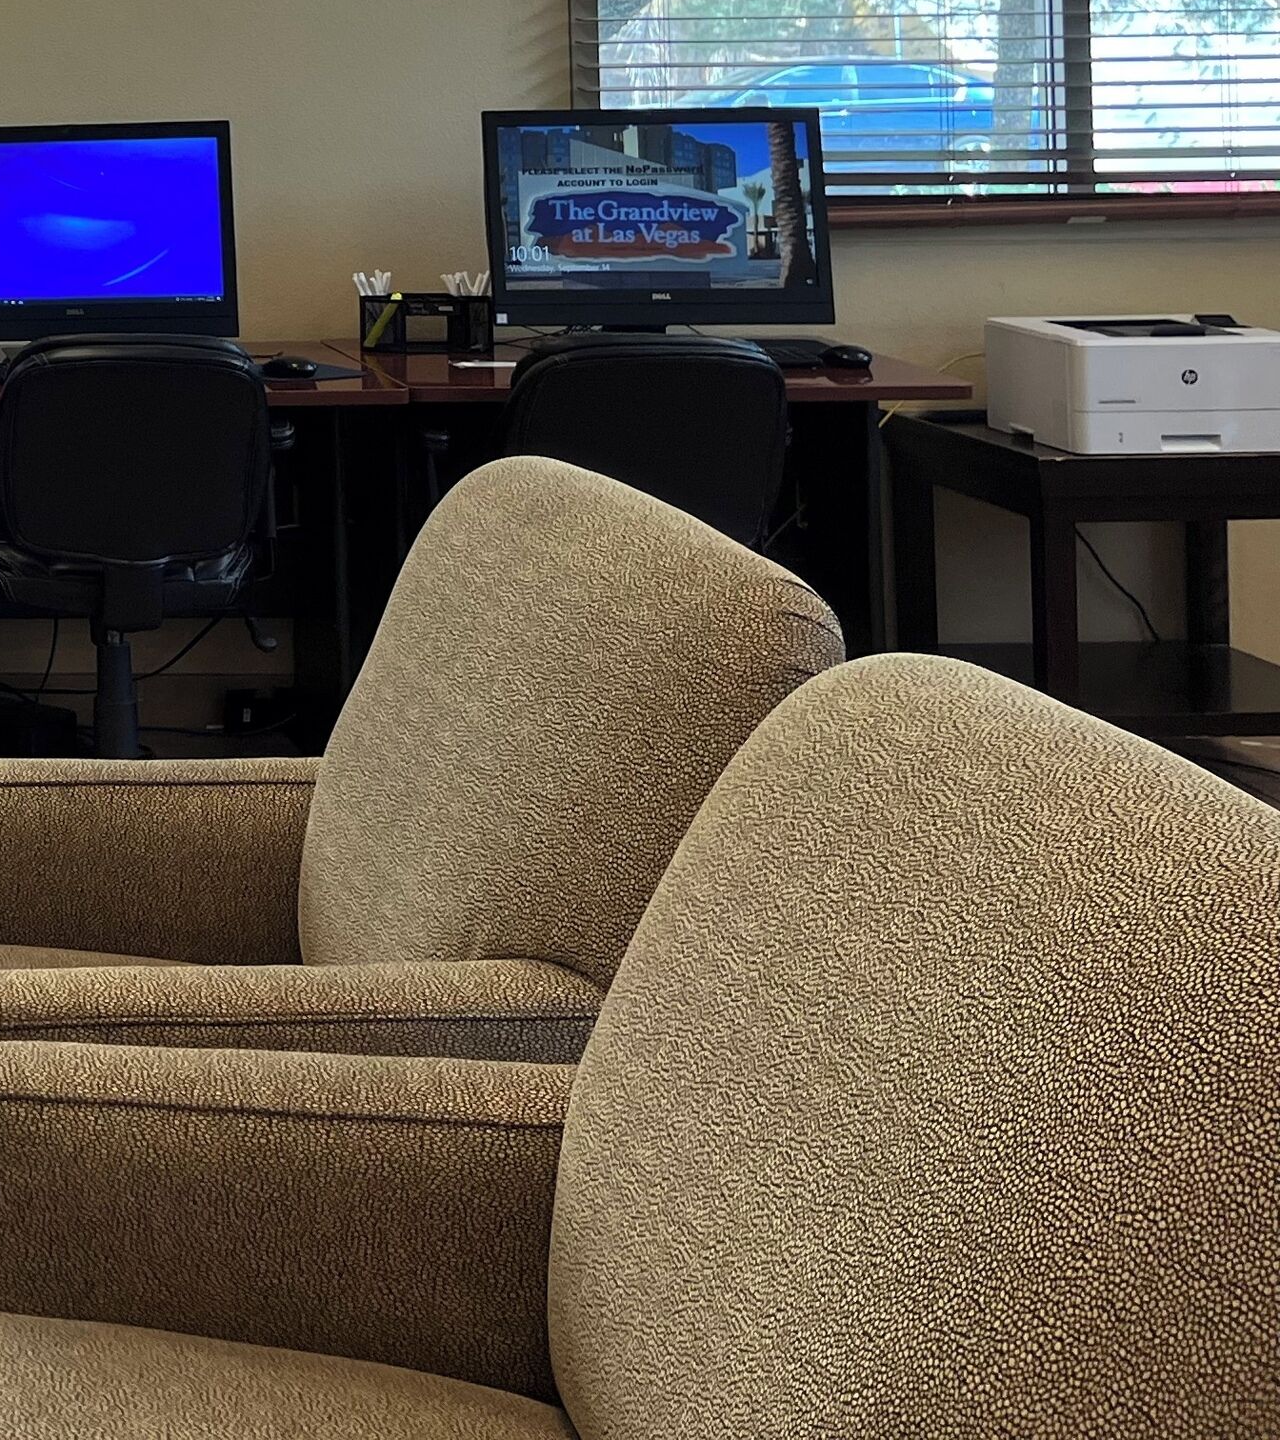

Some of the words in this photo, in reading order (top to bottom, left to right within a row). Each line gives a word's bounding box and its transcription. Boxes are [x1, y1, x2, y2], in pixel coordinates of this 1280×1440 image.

[522, 167, 561, 176] PLEASE
[562, 167, 599, 175] SELECT
[602, 166, 623, 174] THE
[557, 179, 606, 187] ACCOUNT
[548, 199, 595, 221] The
[597, 200, 719, 222] Grandview
[572, 228, 592, 243] at
[597, 223, 635, 243] Las
[637, 223, 701, 248] Vegas
[510, 245, 550, 262] 10:01
[652, 293, 672, 301] DELL
[1182, 369, 1197, 384] hp
